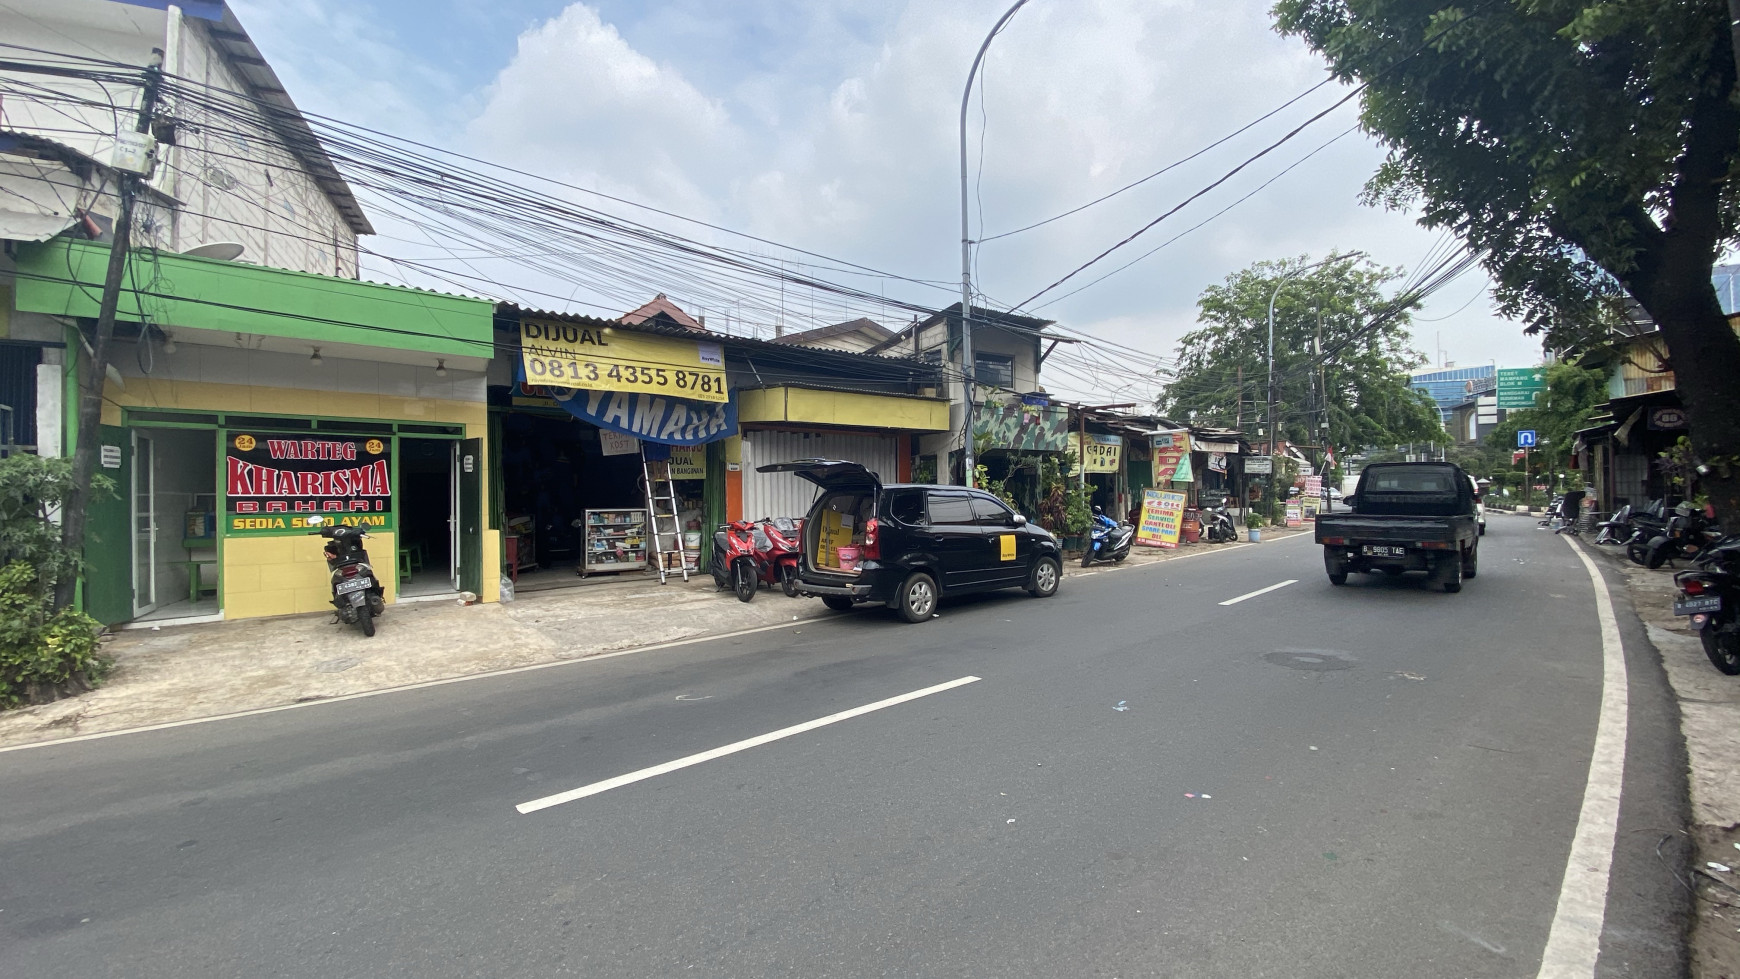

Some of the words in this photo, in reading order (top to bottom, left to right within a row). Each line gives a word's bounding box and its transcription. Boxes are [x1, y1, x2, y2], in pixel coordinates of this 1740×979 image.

[525, 323, 608, 346] DIJUAL
[528, 344, 576, 360] ALVIN
[529, 357, 600, 381] 0813
[607, 364, 668, 386] 4355
[675, 370, 724, 394] 8781
[238, 436, 253, 445] 24
[368, 441, 381, 449] 24
[267, 439, 357, 461] WARTEG
[1086, 445, 1117, 457] GADAI
[226, 455, 391, 497] KHARISMA
[236, 500, 383, 513] BAHARI
[233, 517, 286, 530] SEDIA
[340, 515, 385, 527] AYAM
